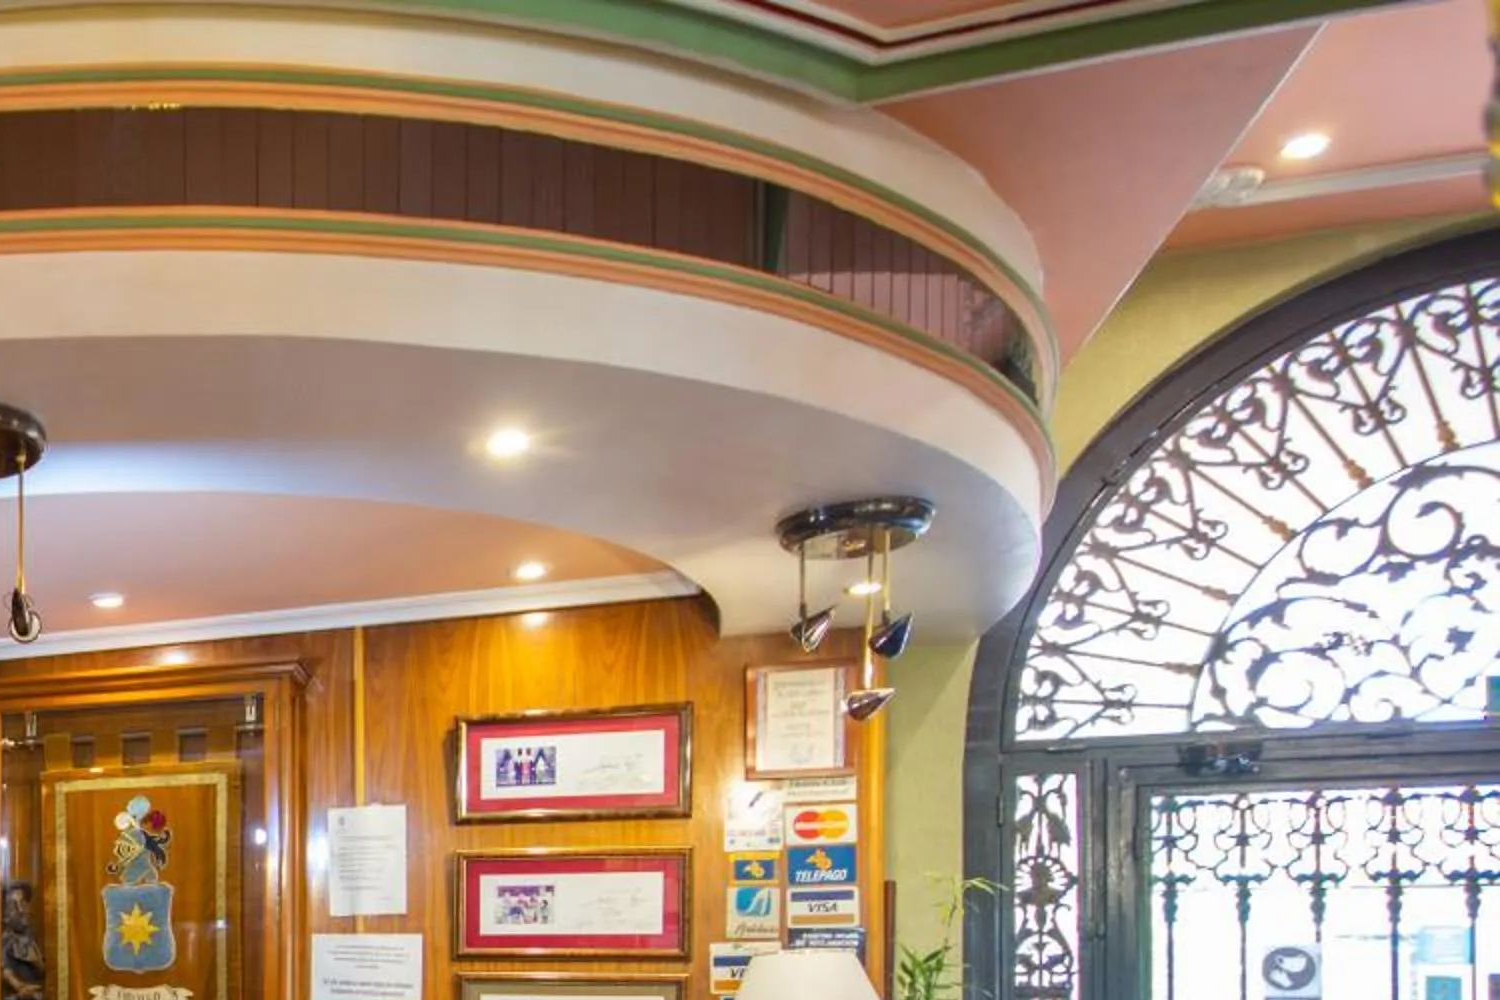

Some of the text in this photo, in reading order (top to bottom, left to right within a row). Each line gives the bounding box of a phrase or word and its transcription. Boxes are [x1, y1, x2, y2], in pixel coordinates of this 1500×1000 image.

[795, 868, 848, 883] TELEPAGO
[807, 901, 838, 913] VISA
[730, 967, 746, 979] VI
